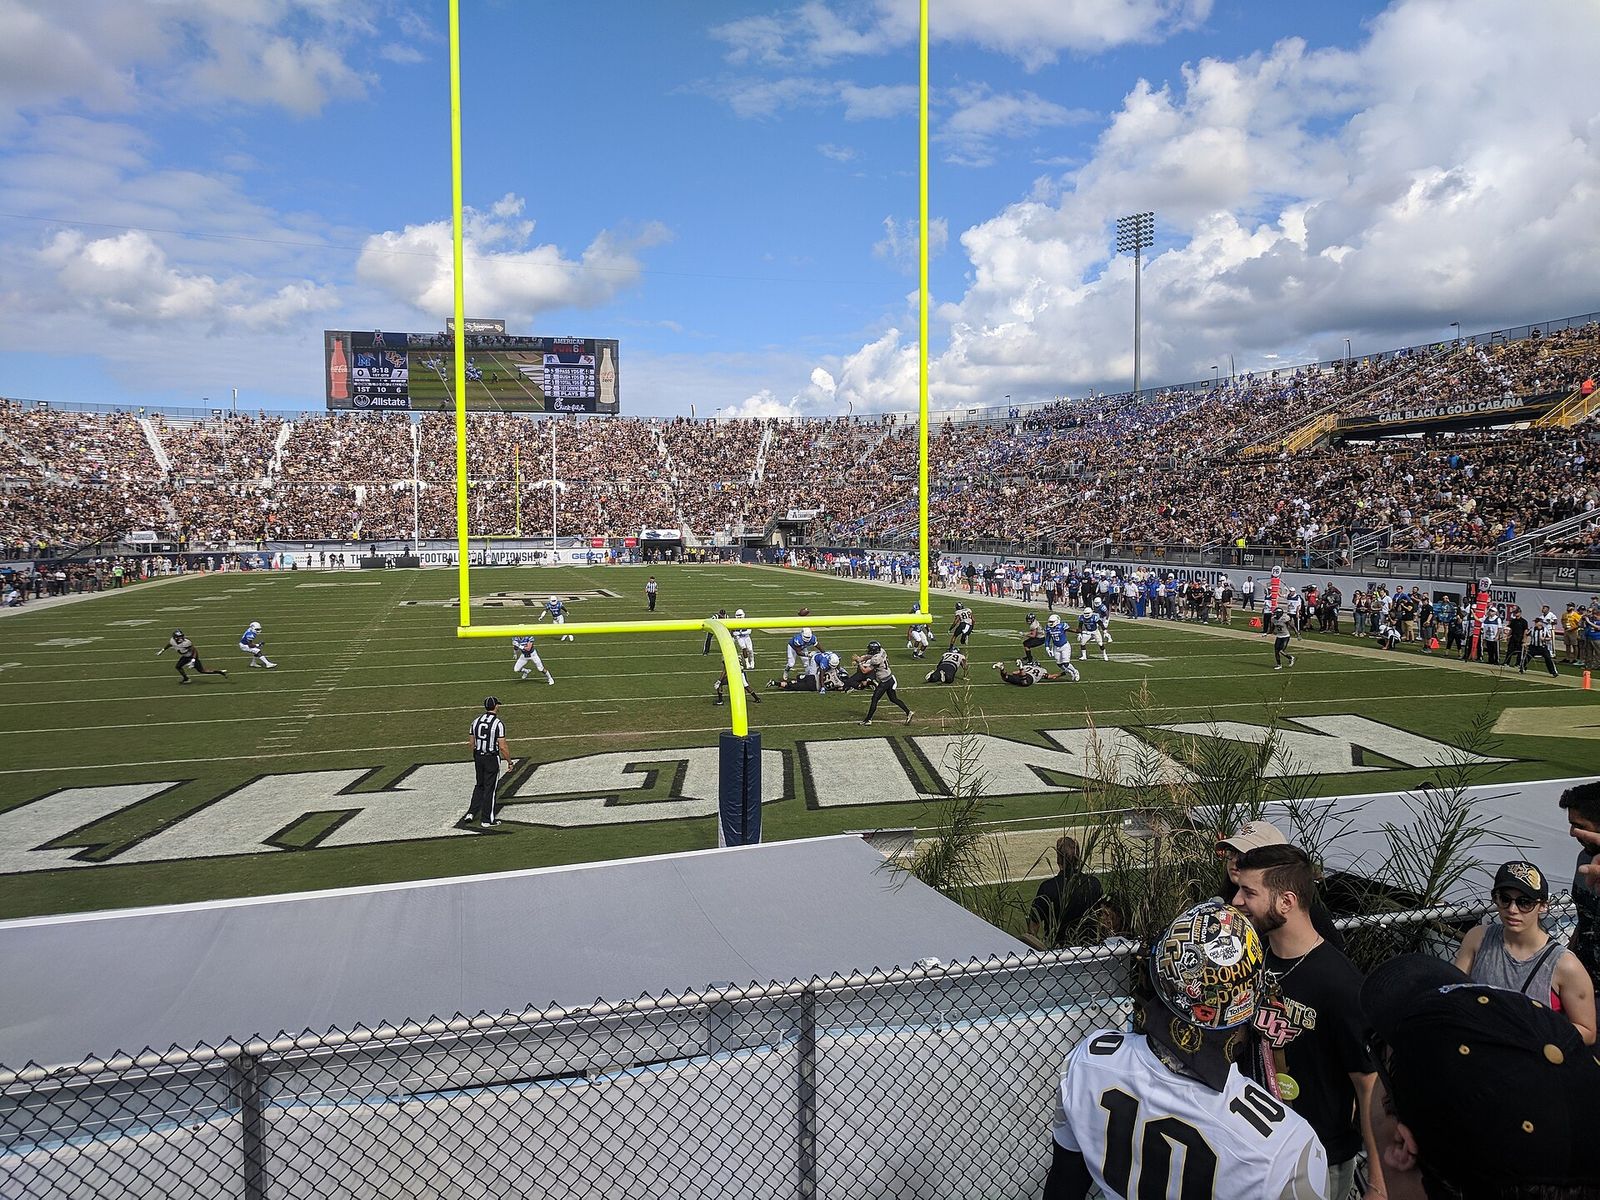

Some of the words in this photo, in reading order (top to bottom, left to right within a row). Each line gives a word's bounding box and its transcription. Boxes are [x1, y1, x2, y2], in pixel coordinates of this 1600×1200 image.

[397, 370, 403, 378] 7
[370, 397, 406, 406] Allstate
[1378, 412, 1403, 423] CARL
[1405, 408, 1437, 420] BLACK
[1439, 408, 1446, 416] &
[1447, 404, 1476, 415] GOLD
[1478, 398, 1524, 411] CABANA
[351, 554, 367, 564] TH
[420, 553, 458, 563] FOOTBAL
[1376, 559, 1389, 568] 131
[1558, 567, 1576, 578] 132
[1489, 590, 1516, 603] RICAN
[944, 652, 960, 663] 79
[478, 723, 488, 739] C
[1193, 915, 1203, 943] KNIGHT
[1201, 915, 1209, 943] BIRTHDAY
[1203, 958, 1253, 985] BORN
[1254, 1006, 1302, 1047] UCF
[1229, 1084, 1286, 1138] 10
[1100, 1088, 1218, 1200] 10
